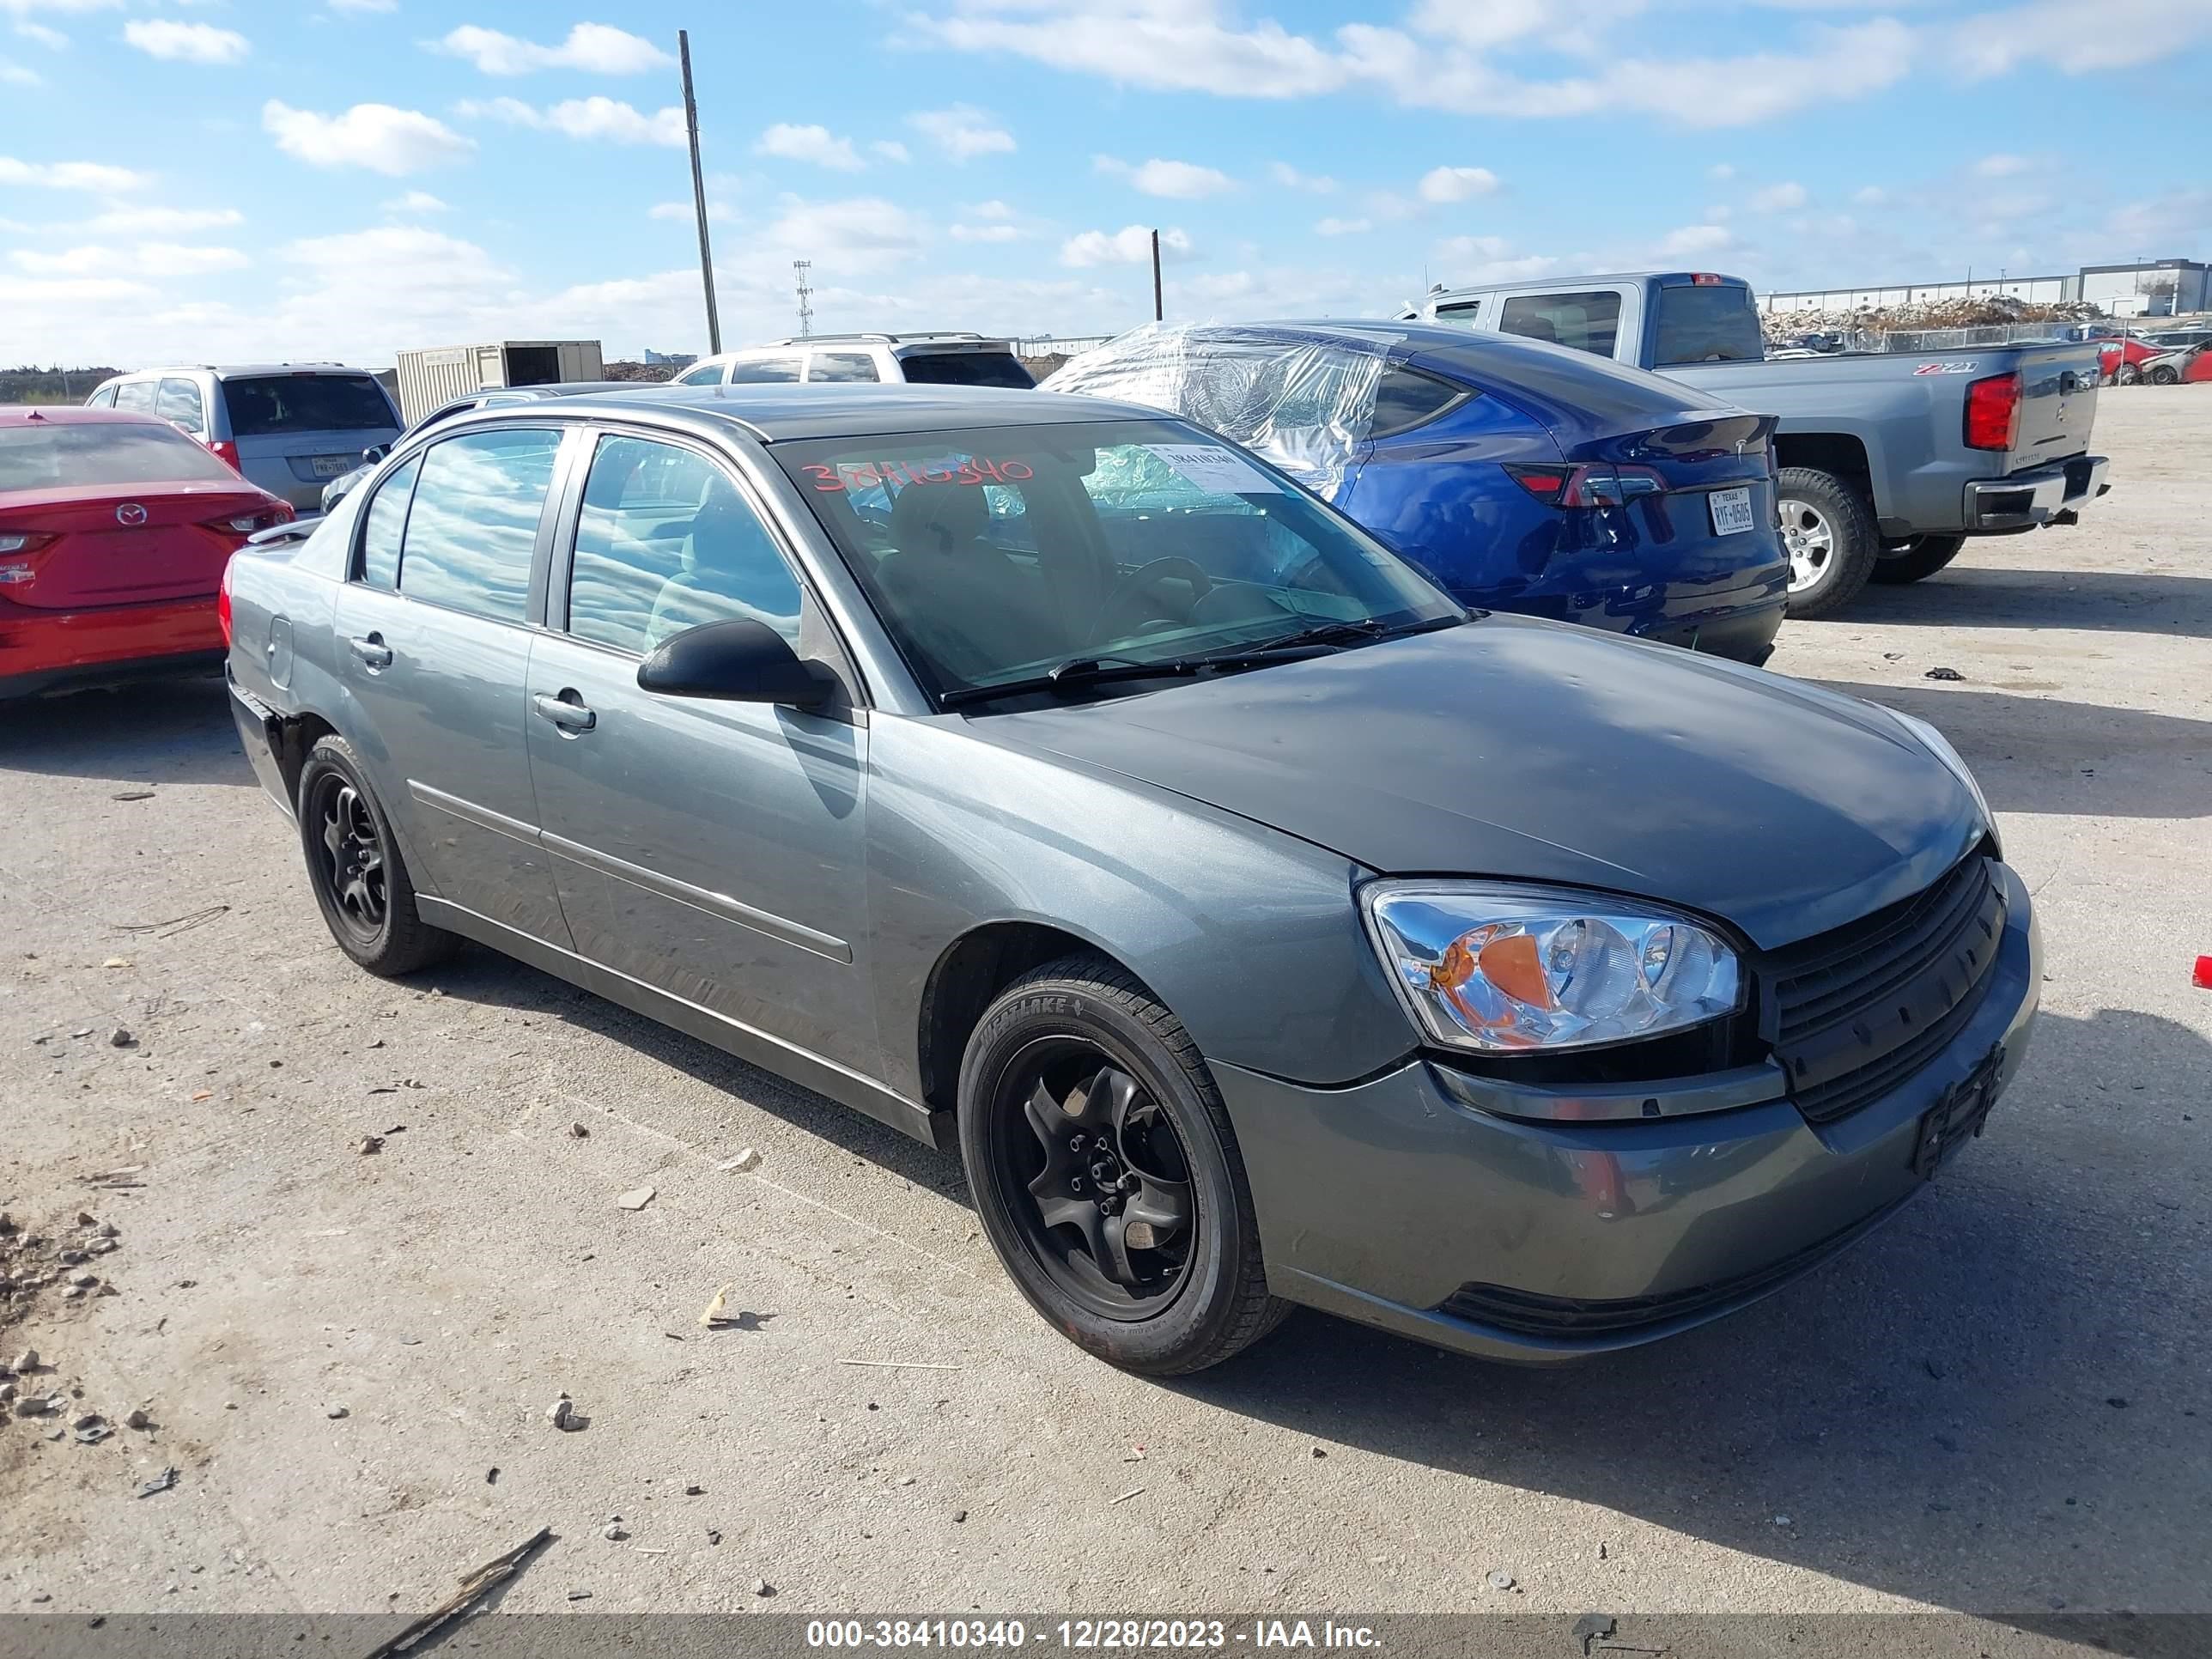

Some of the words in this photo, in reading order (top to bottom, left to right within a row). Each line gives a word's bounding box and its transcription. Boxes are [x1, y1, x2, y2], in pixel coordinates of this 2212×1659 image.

[1913, 362, 1978, 375] Z71
[1168, 454, 1237, 465] 38410340
[1722, 492, 1739, 502] TEXAS
